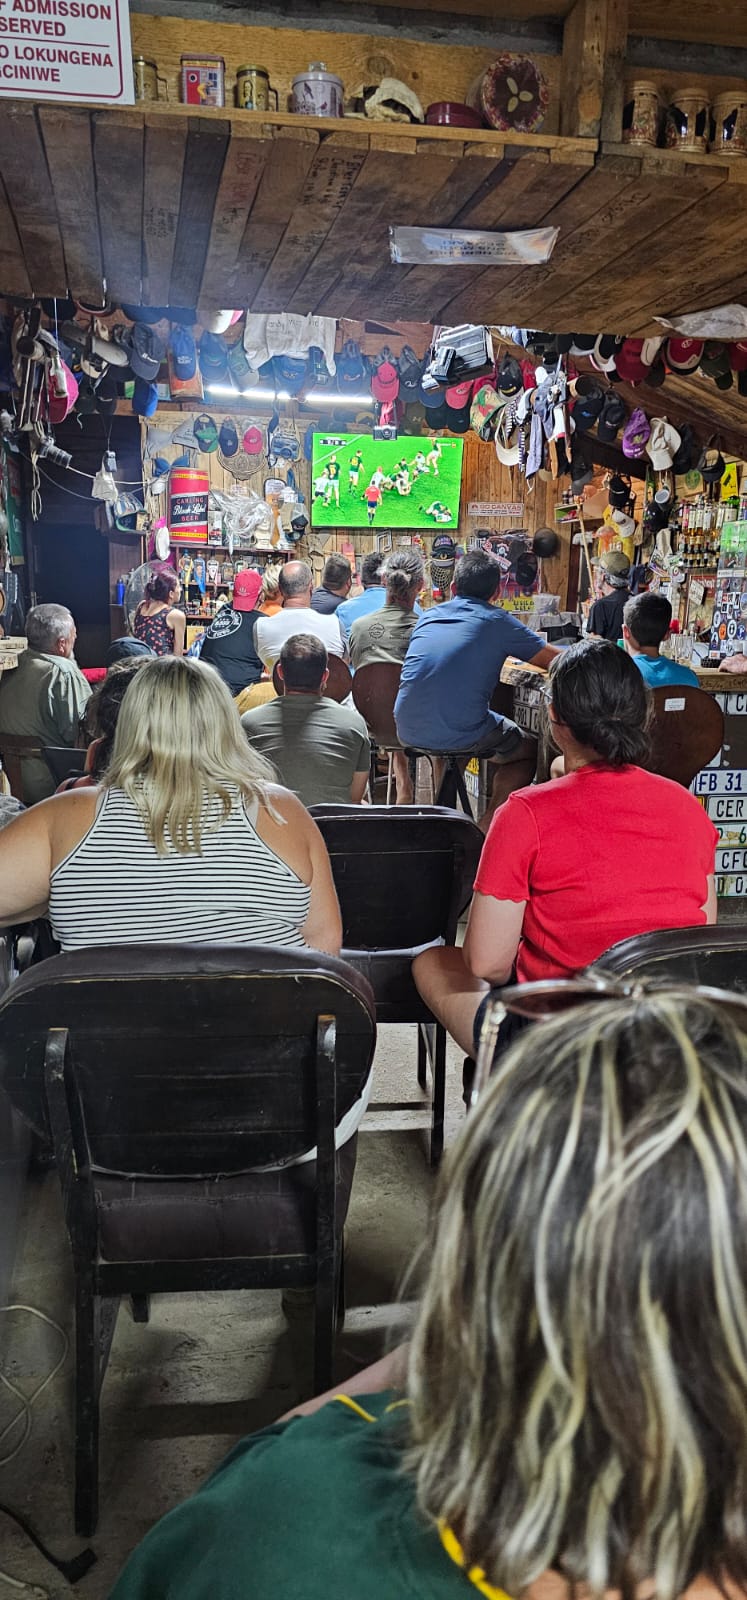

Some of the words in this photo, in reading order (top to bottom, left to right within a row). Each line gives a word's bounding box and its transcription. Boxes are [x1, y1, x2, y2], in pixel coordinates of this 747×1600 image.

[12, 0, 112, 20] ADMISSION
[0, 16, 66, 36] SERVED
[14, 45, 114, 67] LOKUNGENA
[0, 64, 61, 82] CINIWE
[176, 496, 204, 505] CARLING
[698, 773, 717, 791] FB
[725, 773, 742, 791] 31
[716, 800, 744, 817] CER
